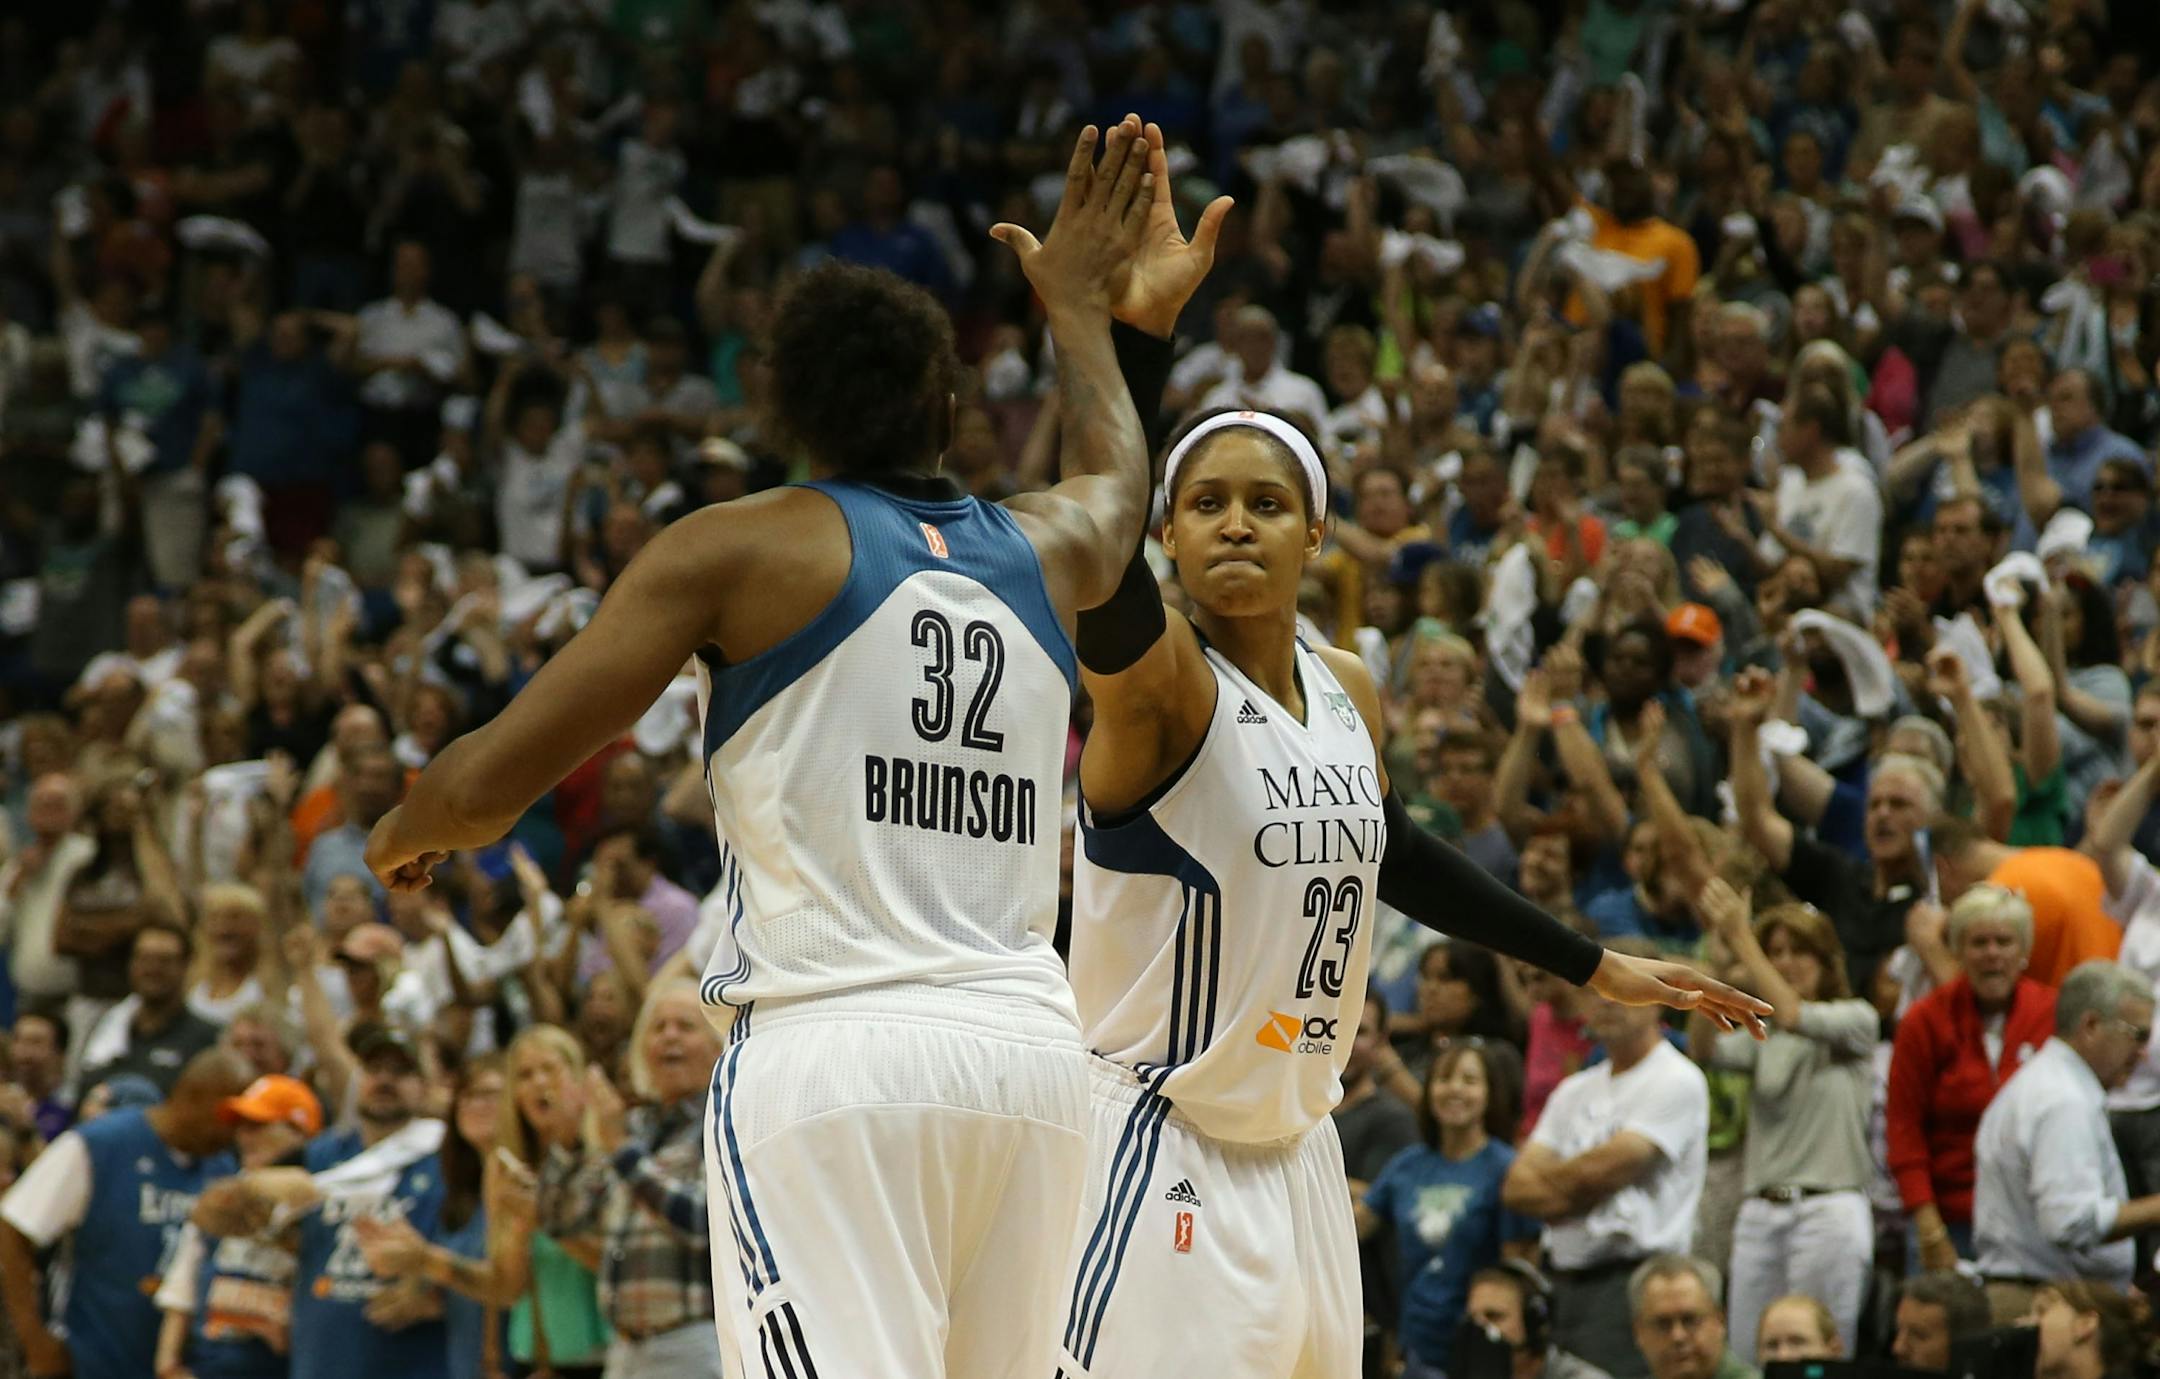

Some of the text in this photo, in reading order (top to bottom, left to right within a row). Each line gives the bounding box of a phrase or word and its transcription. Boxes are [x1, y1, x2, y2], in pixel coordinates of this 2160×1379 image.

[911, 609, 1005, 753] 32
[865, 755, 1036, 845] BRUNSON
[1256, 764, 1380, 811] MAYO
[1295, 875, 1364, 999] 23
[1298, 1040, 1332, 1055] obile
[1165, 1190, 1202, 1208] adidas
